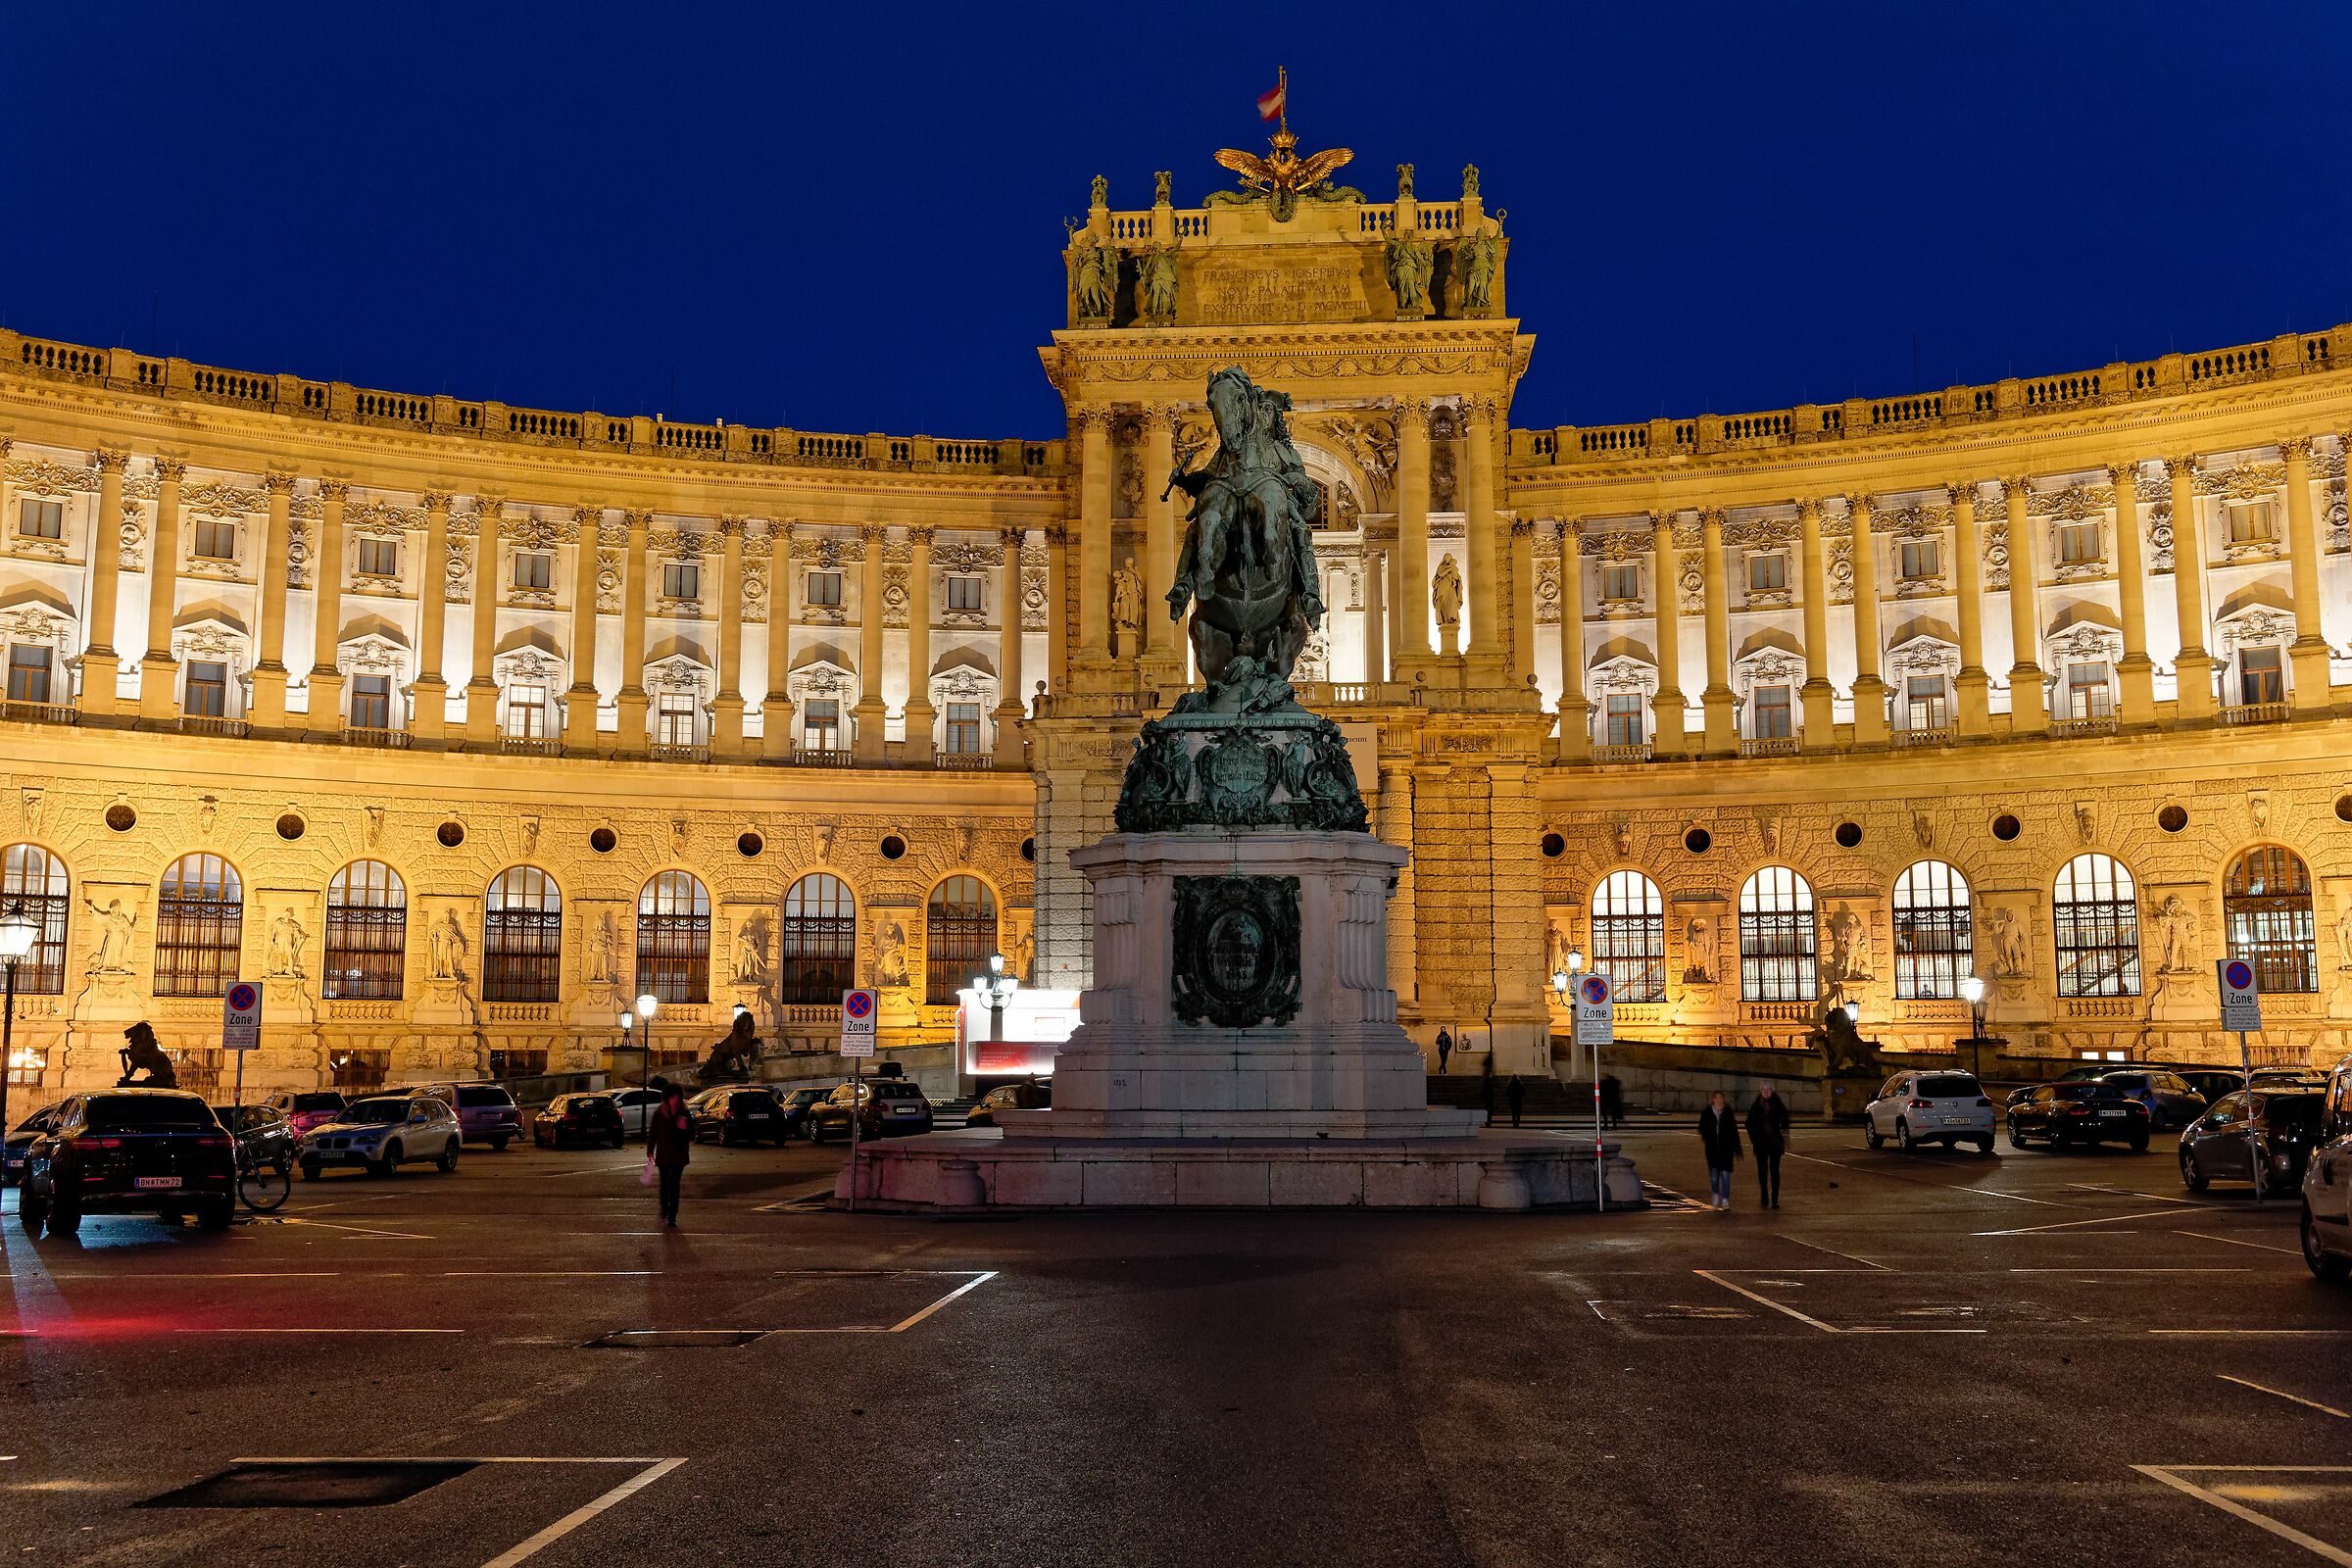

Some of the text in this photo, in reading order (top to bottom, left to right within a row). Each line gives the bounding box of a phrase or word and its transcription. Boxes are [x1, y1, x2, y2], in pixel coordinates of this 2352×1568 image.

[1203, 269, 1280, 281] FRANCISCVS
[1218, 286, 1250, 298] NOVI
[1313, 284, 1350, 295] ALAM
[1281, 302, 1290, 314] A
[1298, 301, 1306, 312] D
[2230, 992, 2252, 1004] Zone
[1584, 1006, 1607, 1018] Zone
[229, 1013, 253, 1024] Zone
[847, 1020, 869, 1032] Zone
